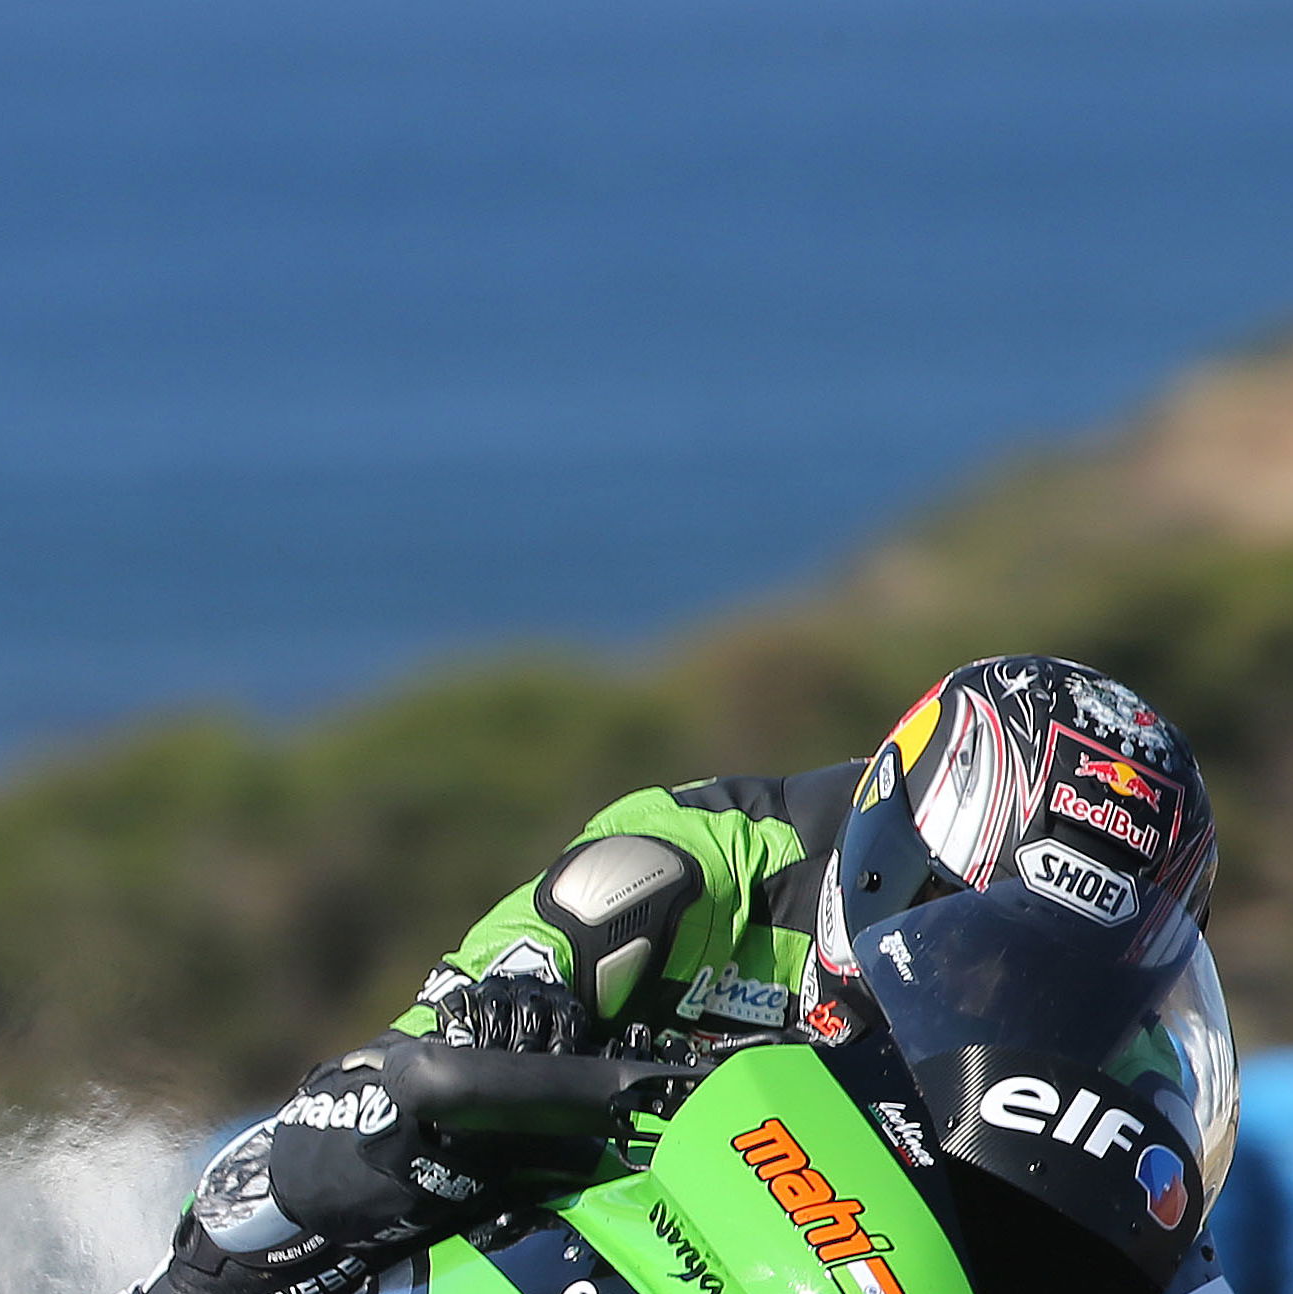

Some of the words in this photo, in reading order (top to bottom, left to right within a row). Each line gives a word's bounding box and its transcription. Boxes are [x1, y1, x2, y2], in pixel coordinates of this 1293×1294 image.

[1050, 783, 1112, 828] Red
[1108, 808, 1160, 859] Bull
[1035, 852, 1128, 917] SHOEI
[979, 1075, 1144, 1159] elf
[731, 1118, 894, 1264] mahi
